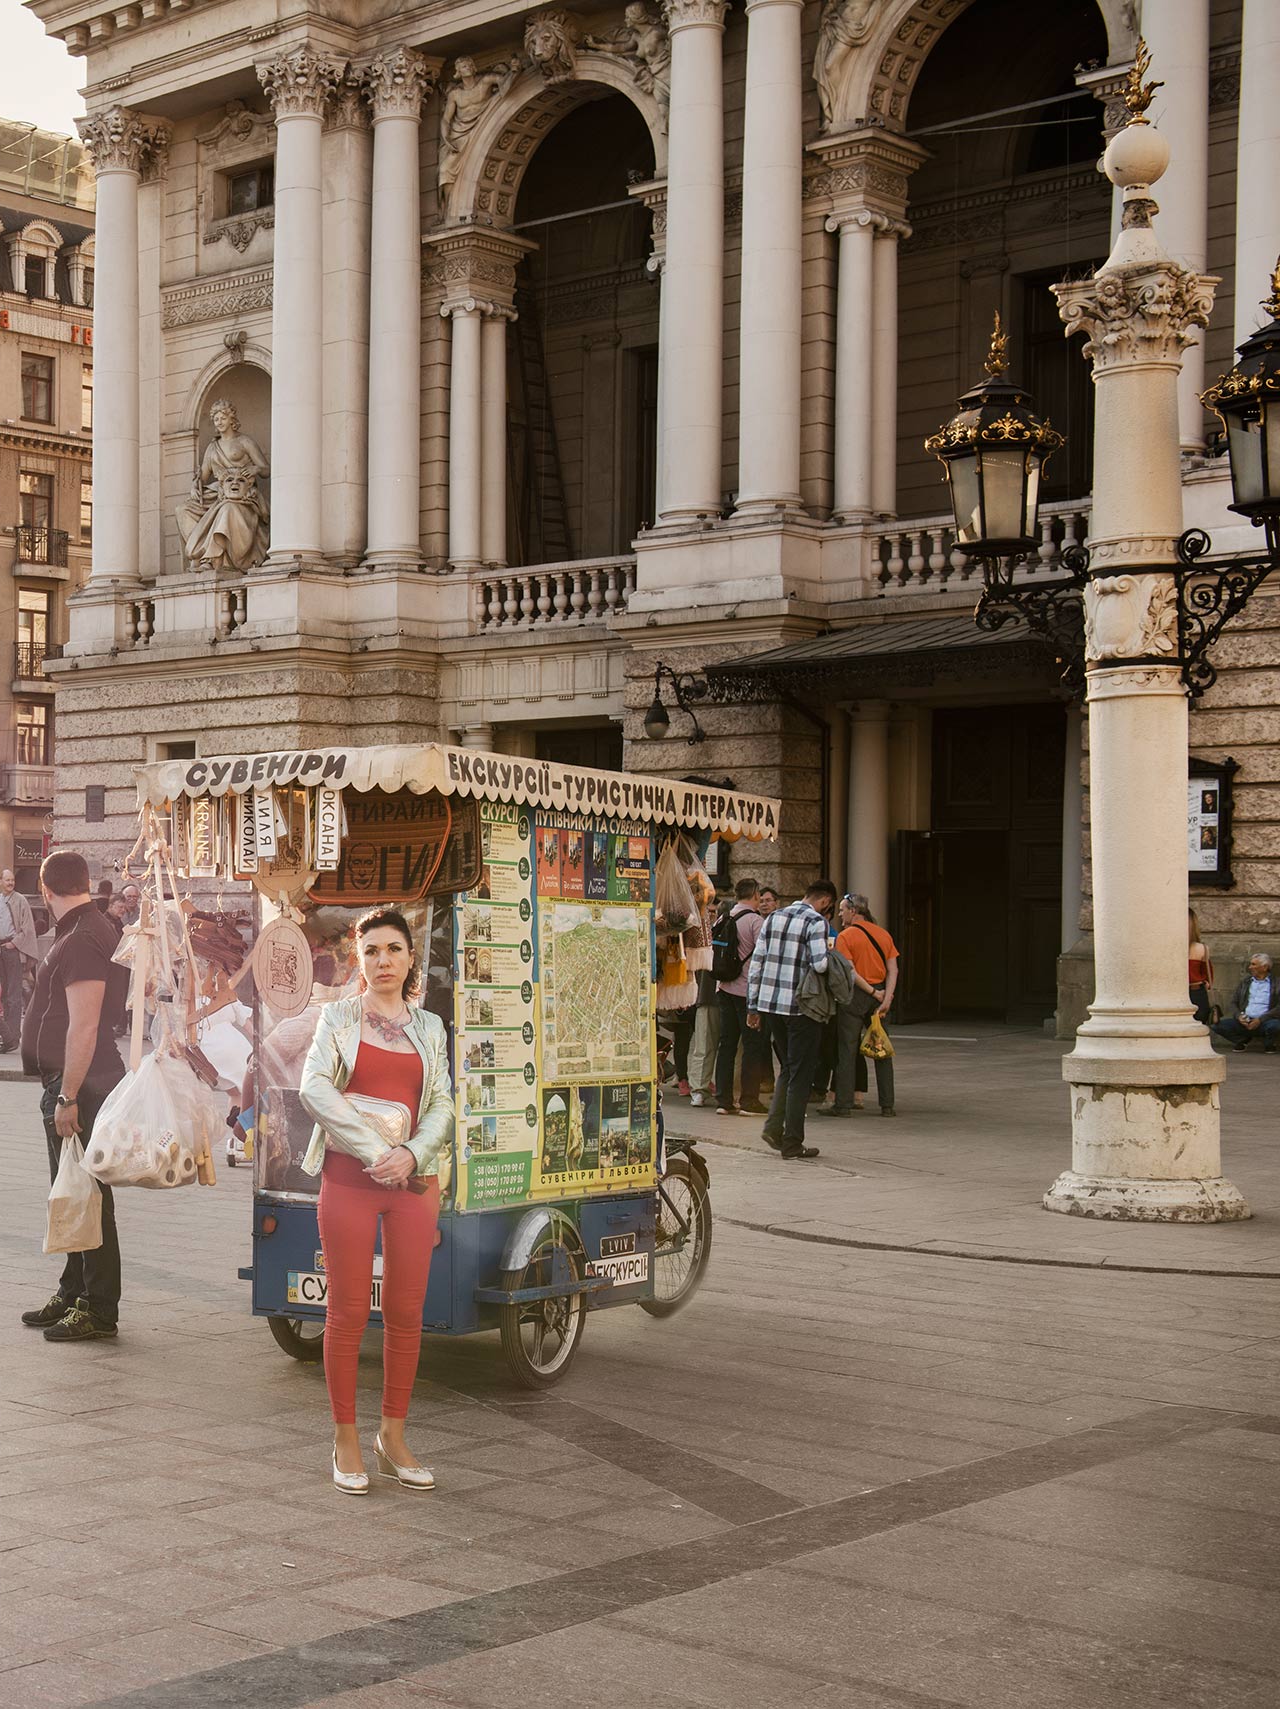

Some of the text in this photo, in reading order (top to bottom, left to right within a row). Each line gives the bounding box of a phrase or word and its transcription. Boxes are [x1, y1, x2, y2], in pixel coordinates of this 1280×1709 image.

[185, 753, 346, 787] СУВЕНІРИ
[322, 790, 335, 856] ОКСАНА
[535, 809, 593, 831] ПУТІВНИКИ
[595, 817, 608, 834] ТА
[609, 818, 650, 837] СУВЕНІРИ
[682, 793, 775, 827] ЛІТЕРАТУРА
[196, 798, 210, 861] KRAINE
[541, 1171, 594, 1184] СУВЕНІРИ
[609, 1165, 649, 1177] ЛЬВОВА
[609, 1238, 628, 1252] LVIV
